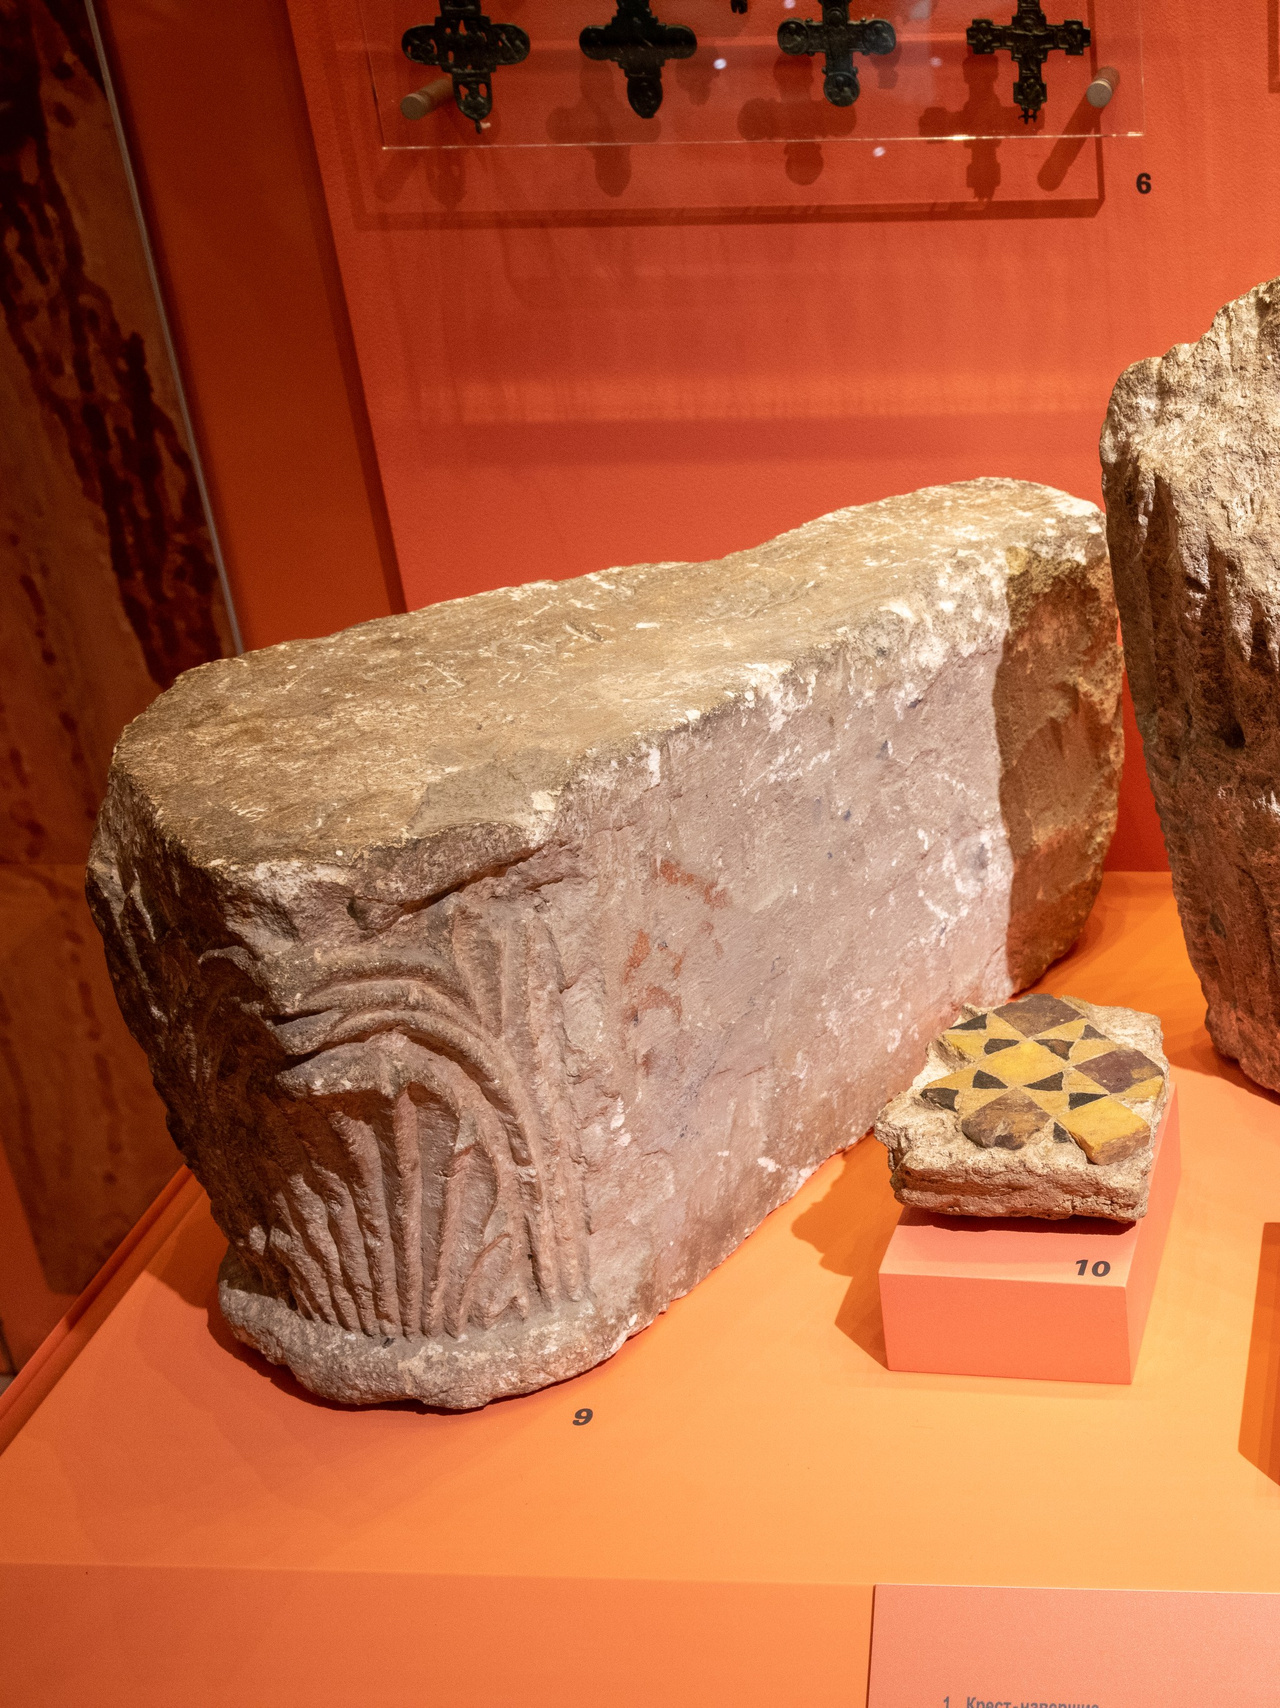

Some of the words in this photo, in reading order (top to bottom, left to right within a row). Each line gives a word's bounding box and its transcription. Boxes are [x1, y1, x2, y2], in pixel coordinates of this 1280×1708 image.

[1136, 172, 1152, 195] 6
[1075, 1259, 1111, 1278] 10
[572, 1408, 594, 1426] 9
